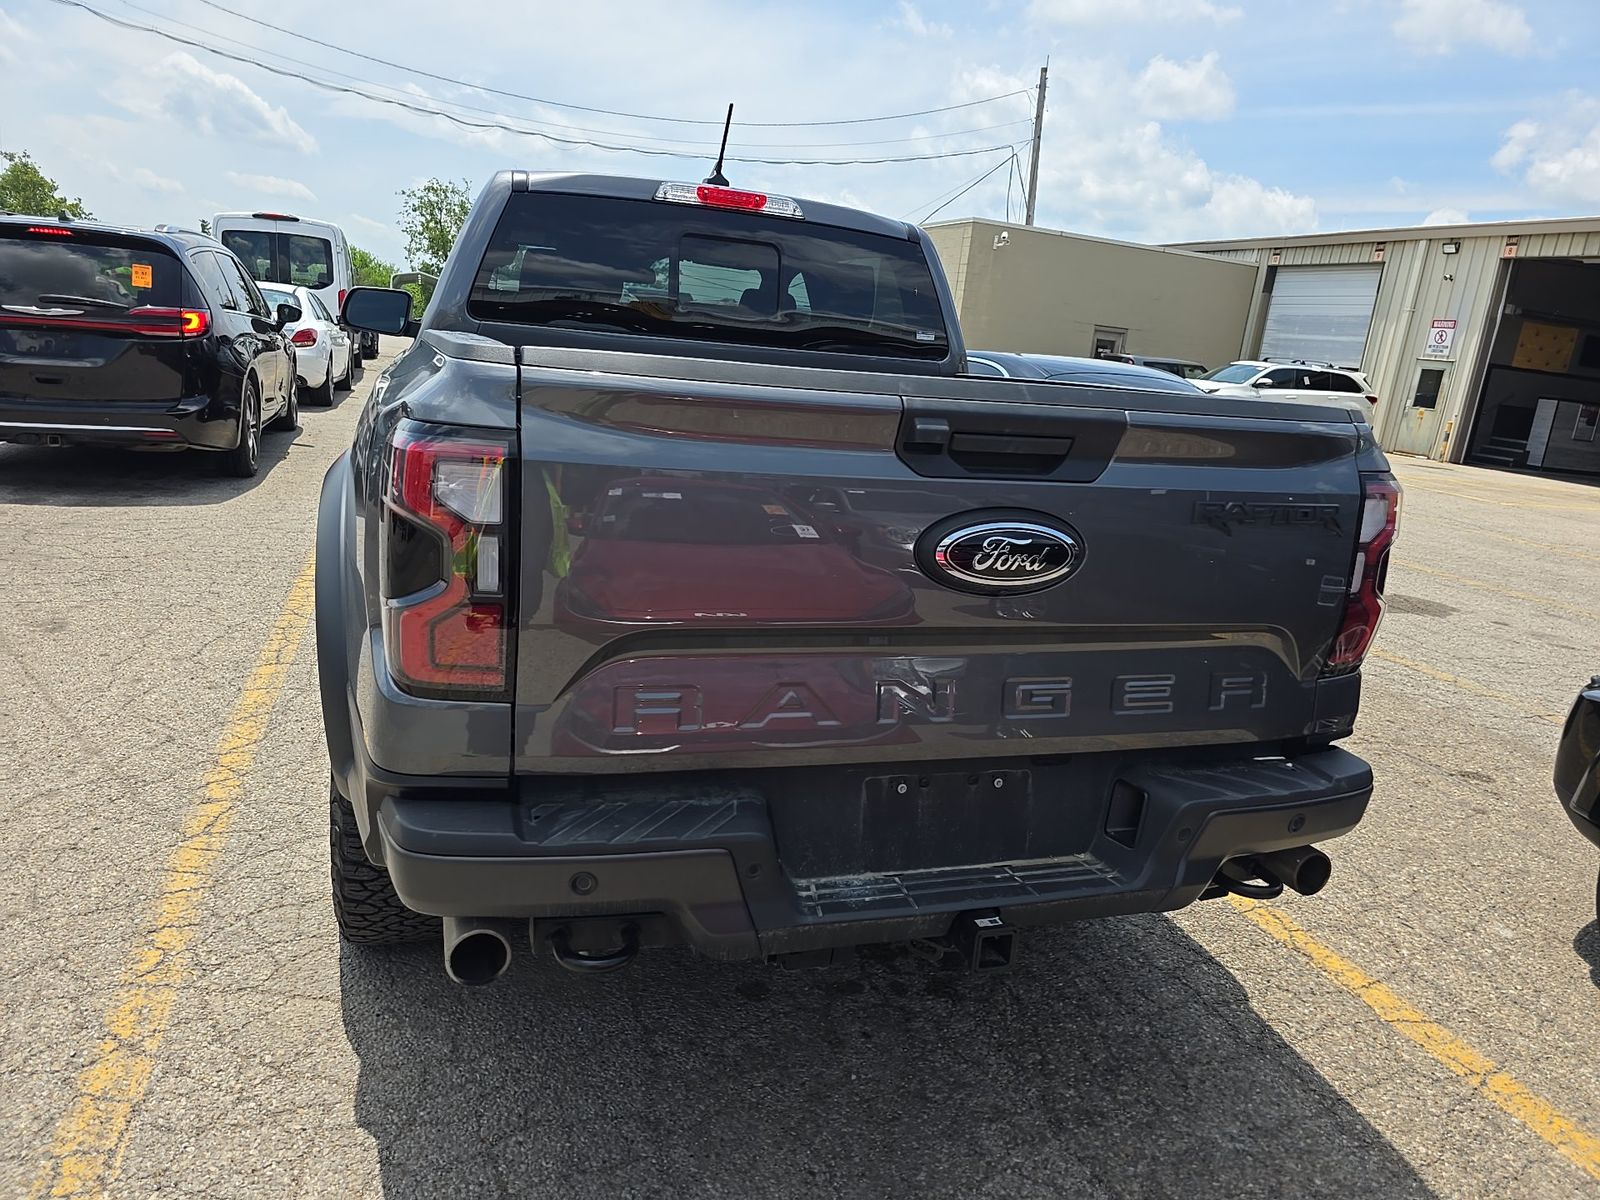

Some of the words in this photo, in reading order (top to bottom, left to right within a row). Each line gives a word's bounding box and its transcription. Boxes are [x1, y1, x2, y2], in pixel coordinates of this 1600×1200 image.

[1191, 501, 1343, 537] RAPTOR
[972, 536, 1050, 571] Ford
[612, 671, 1269, 735] RANGER
